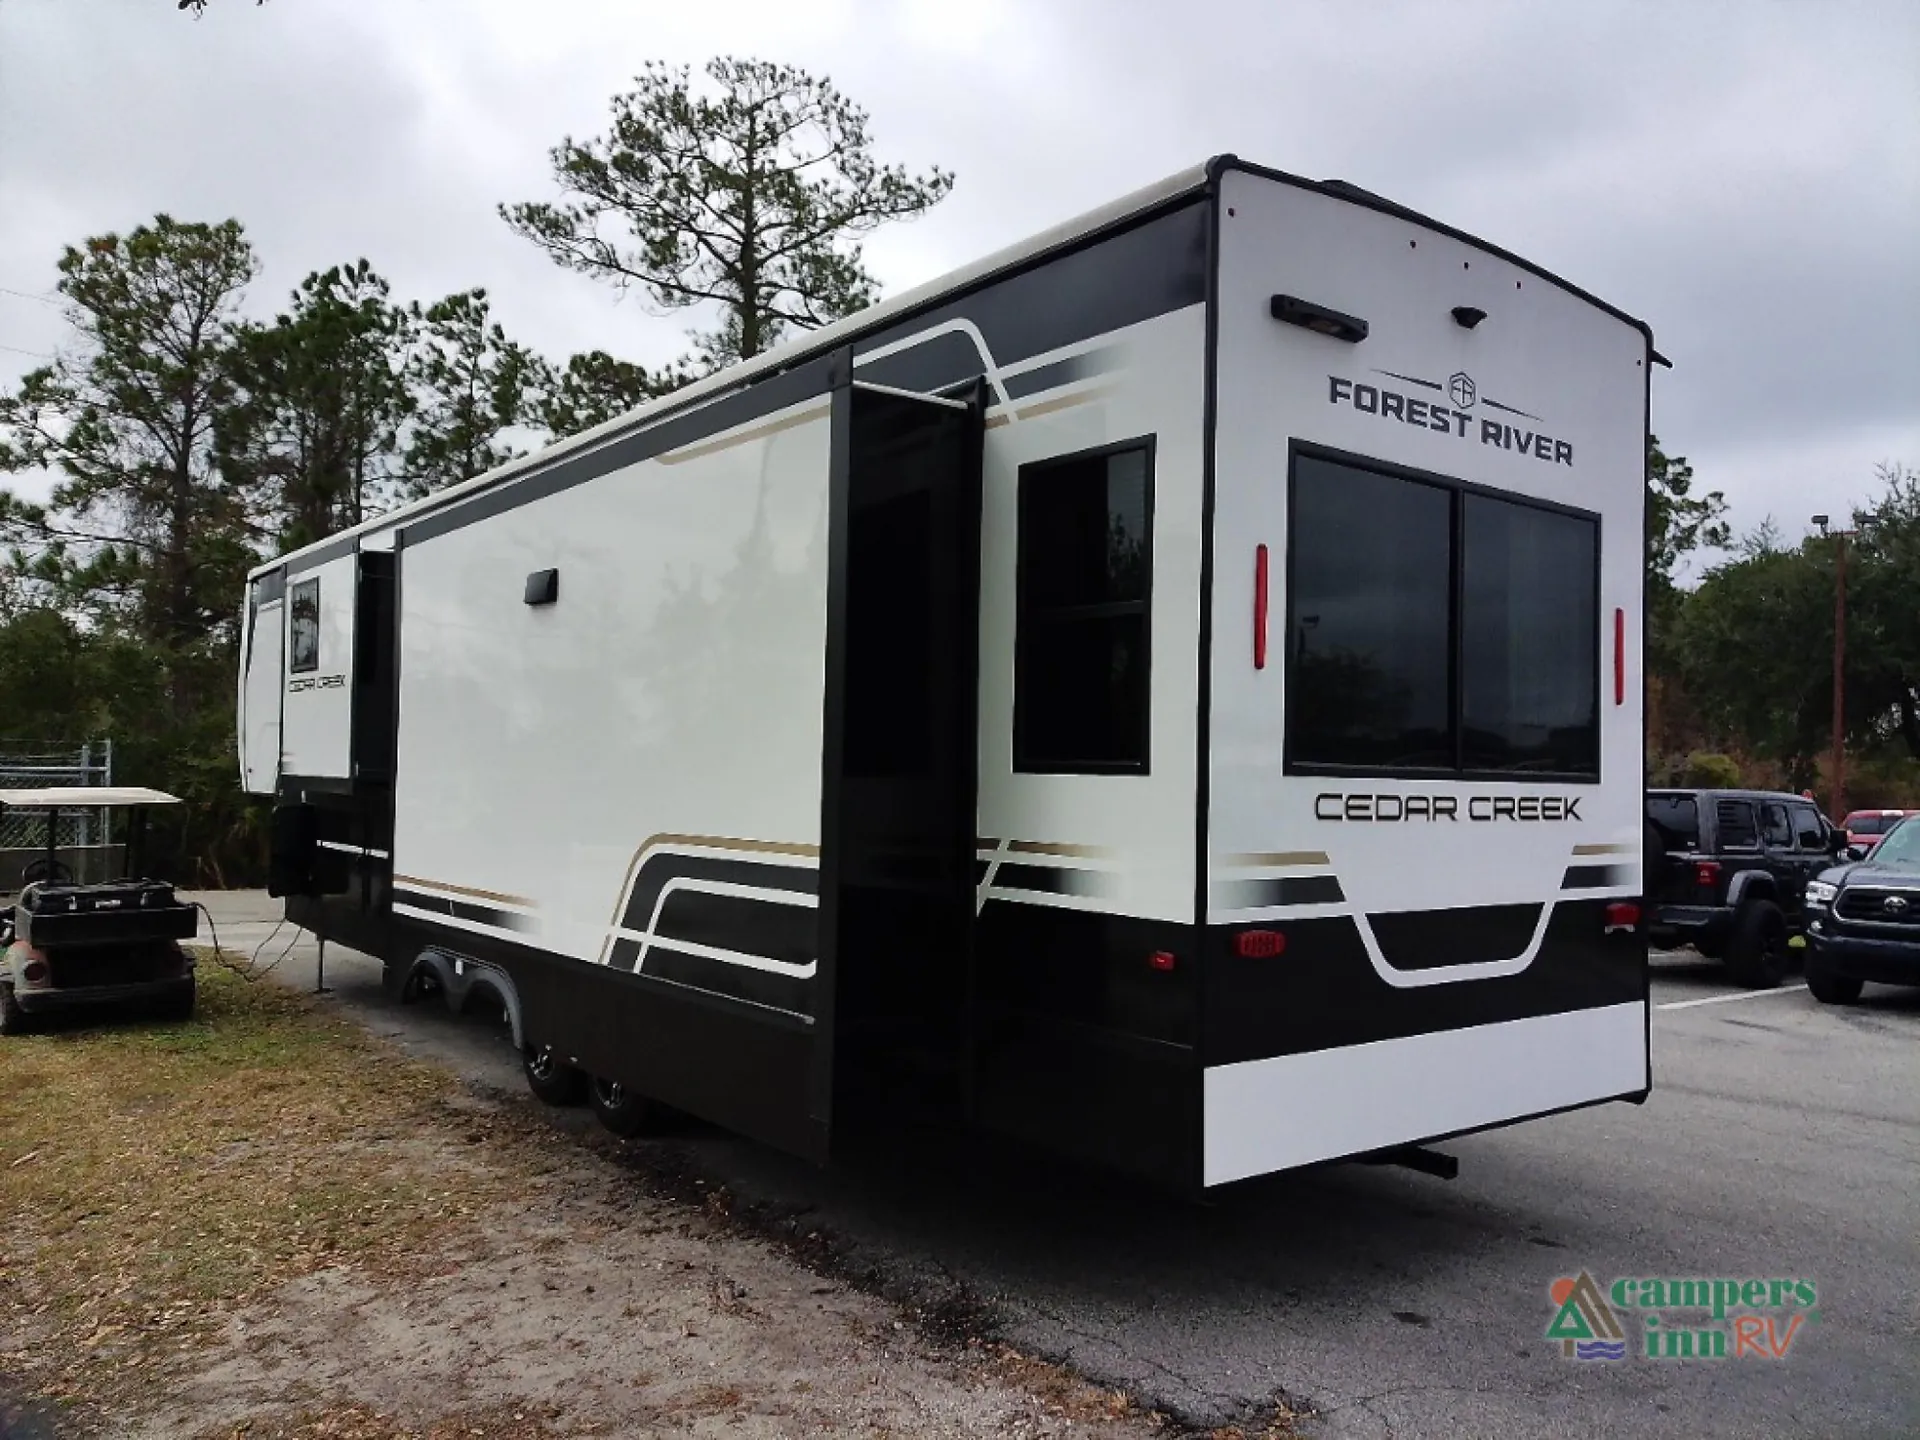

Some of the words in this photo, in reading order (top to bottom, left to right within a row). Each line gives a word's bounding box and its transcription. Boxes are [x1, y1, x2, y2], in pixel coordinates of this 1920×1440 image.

[1328, 375, 1473, 438] FOREST
[1480, 418, 1574, 467] RIVER
[1314, 793, 1459, 822] CEDAR
[1467, 796, 1583, 822] CREEK
